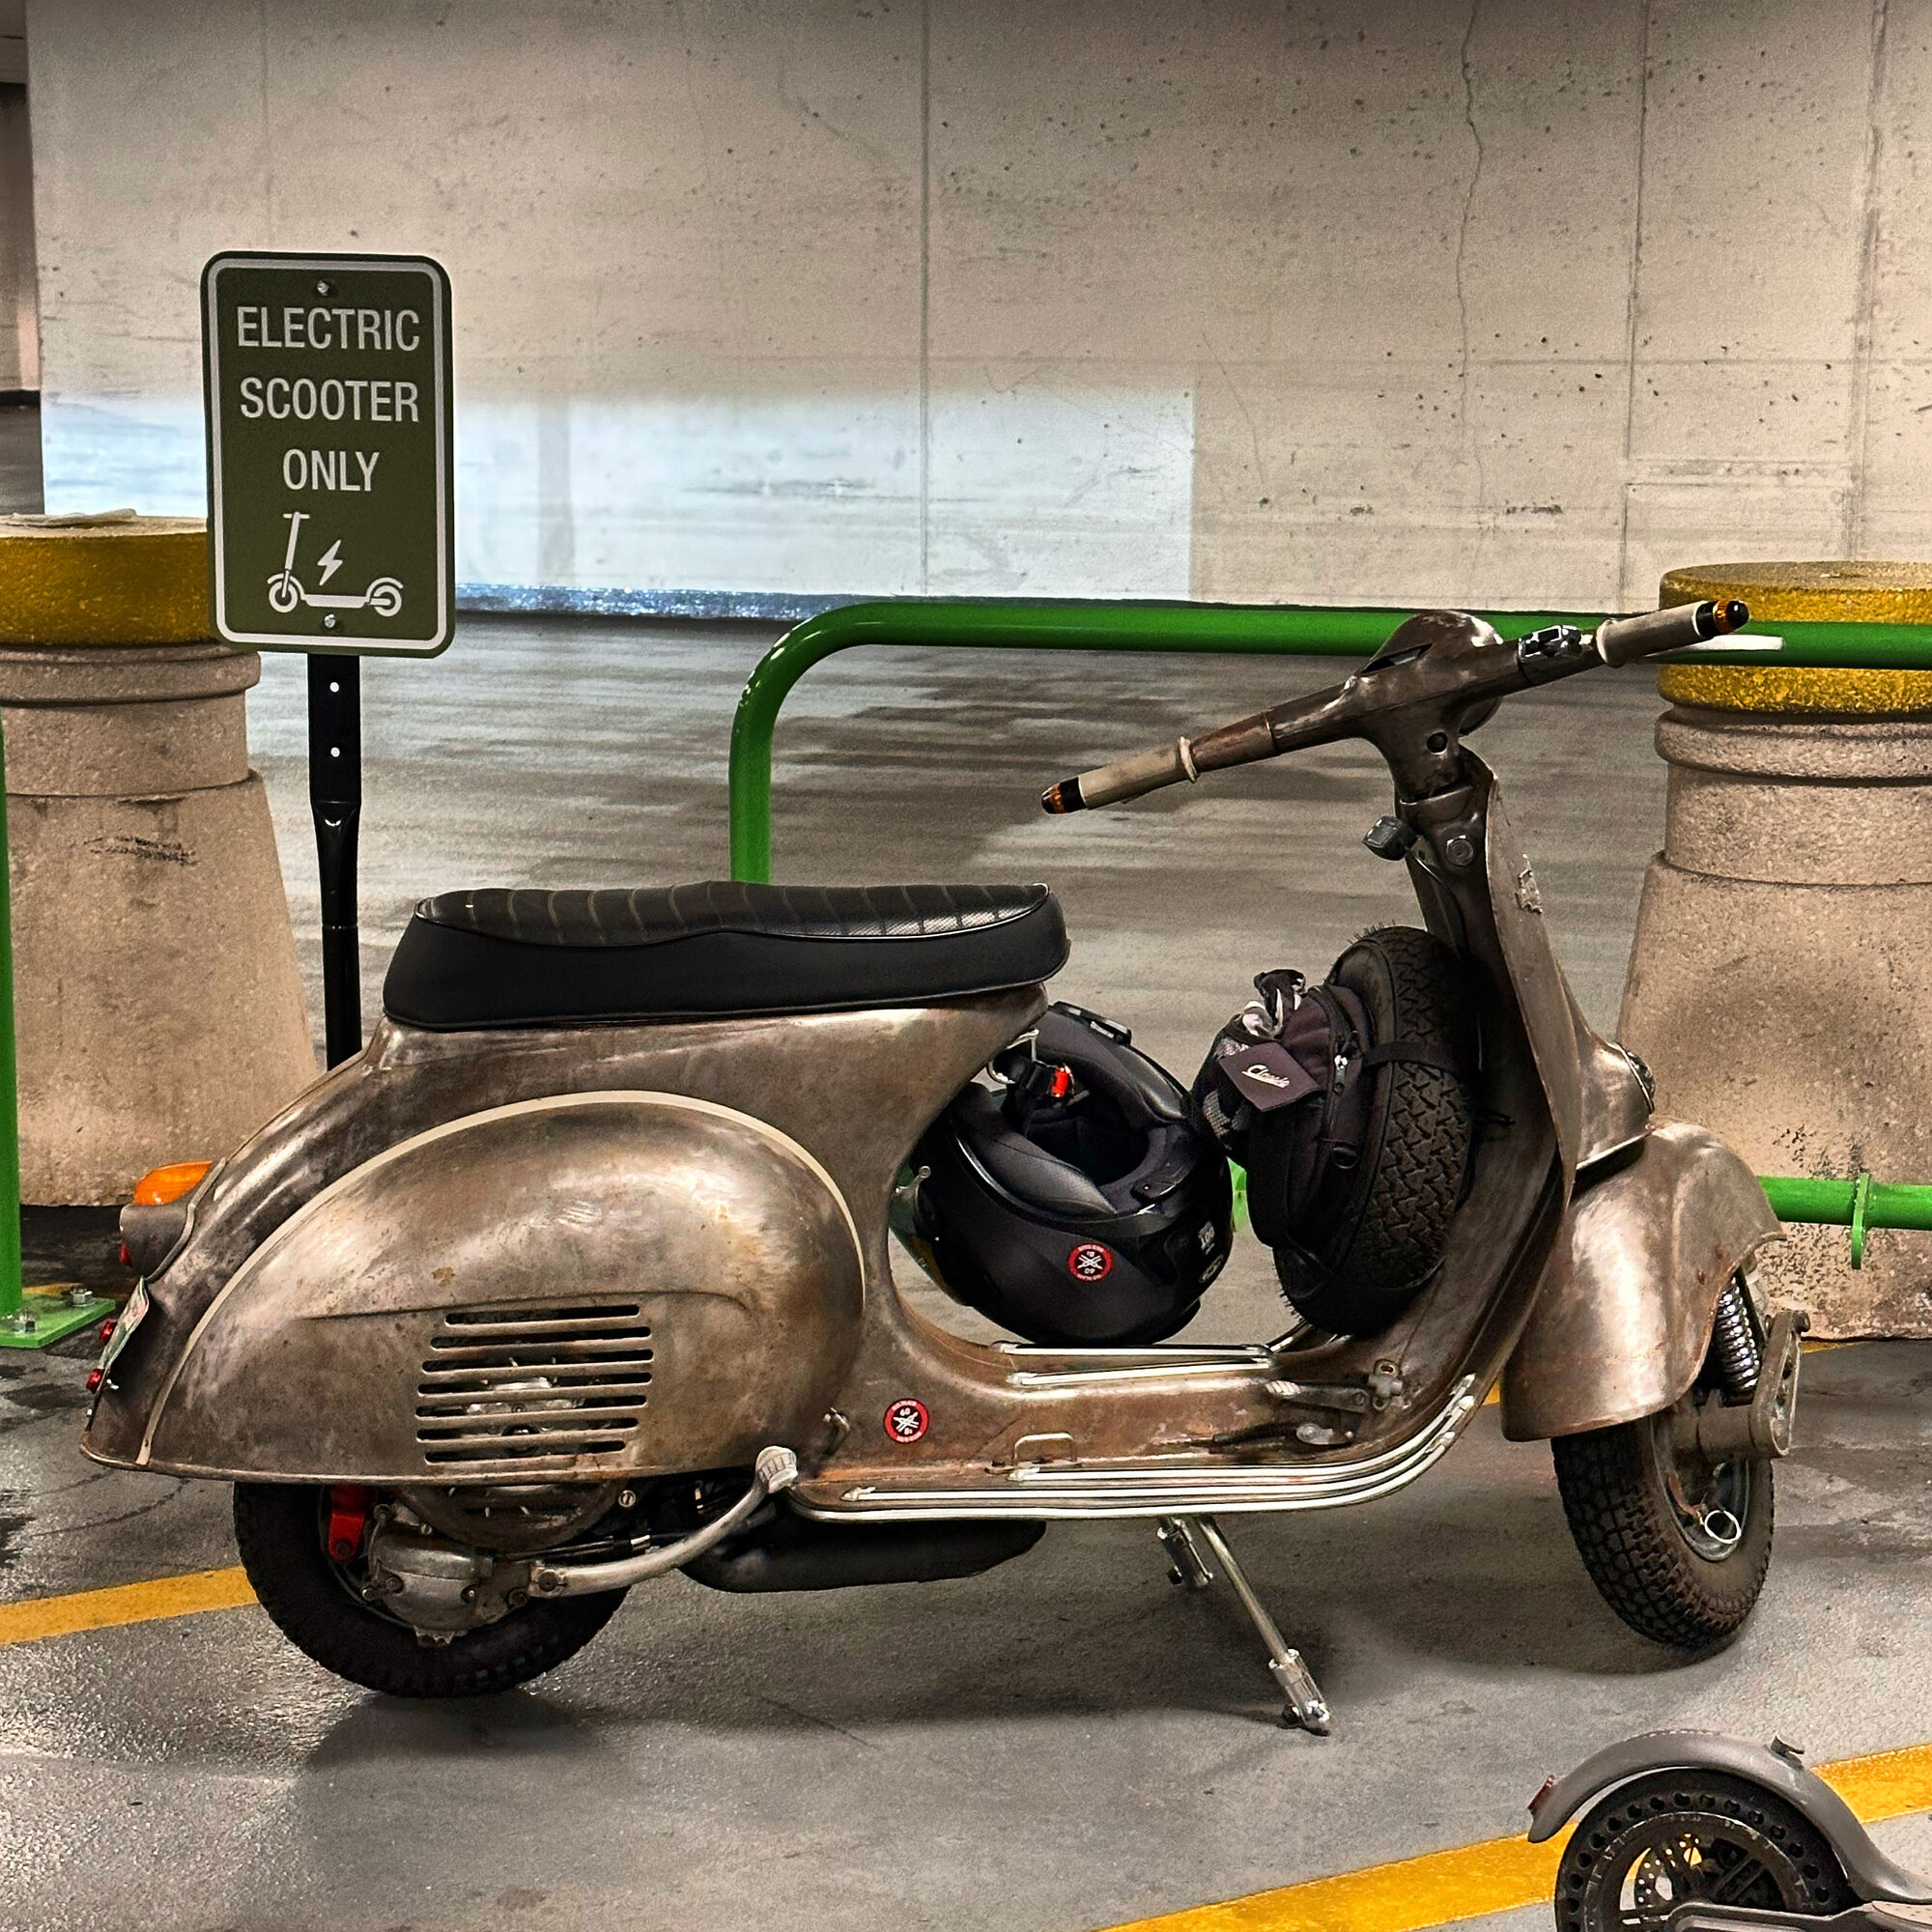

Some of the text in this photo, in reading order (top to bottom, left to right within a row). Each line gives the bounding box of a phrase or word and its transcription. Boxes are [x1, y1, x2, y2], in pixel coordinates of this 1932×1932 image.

[237, 306, 420, 351] ELECTRIC
[241, 378, 419, 422] SCOOTER
[283, 449, 380, 492] ONLY
